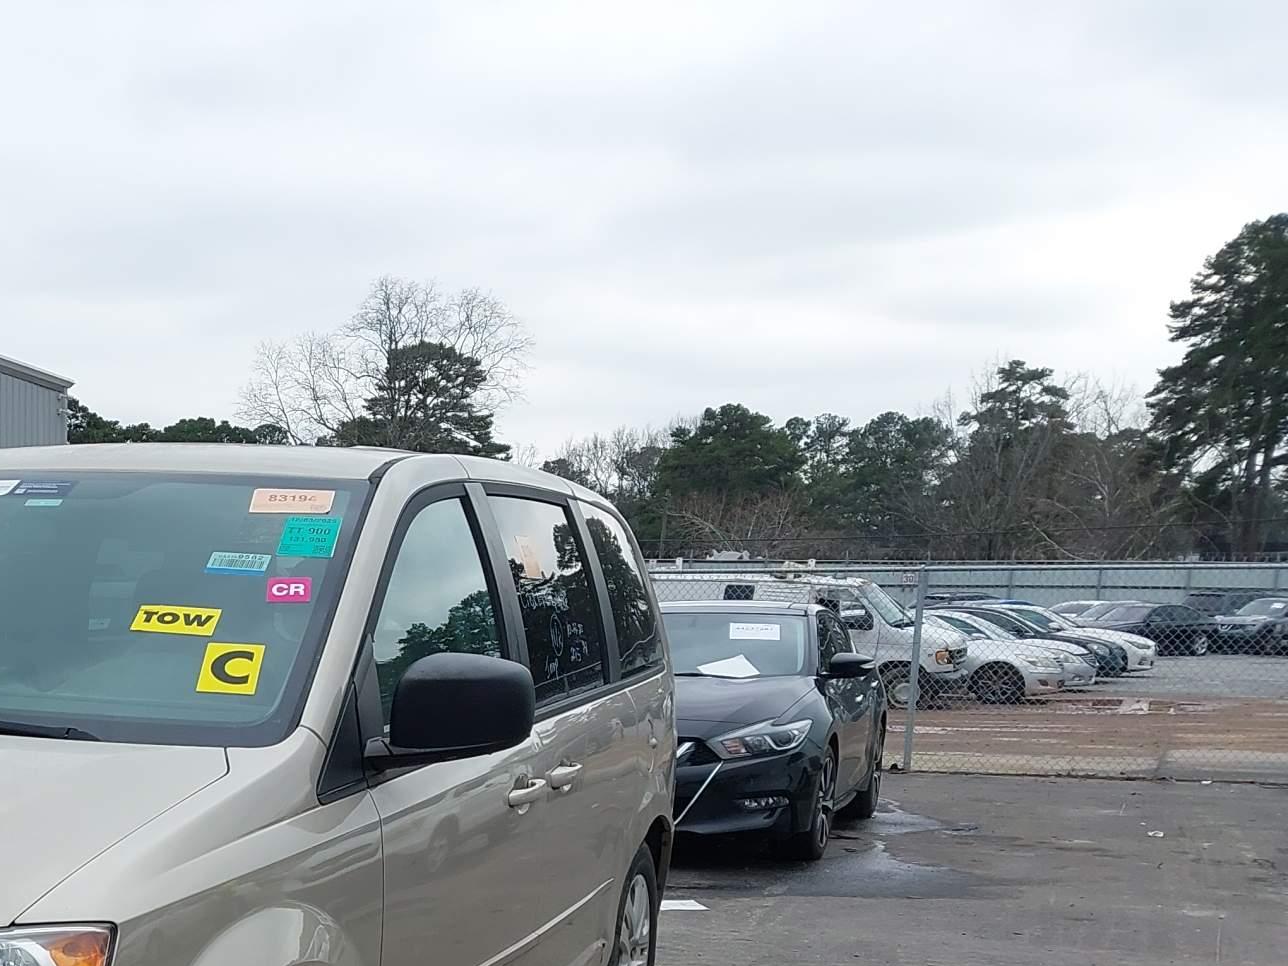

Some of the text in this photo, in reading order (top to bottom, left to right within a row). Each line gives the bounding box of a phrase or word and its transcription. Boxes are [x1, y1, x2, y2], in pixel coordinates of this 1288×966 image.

[271, 583, 305, 596] CR
[142, 610, 215, 627] TOW
[210, 650, 255, 685] C
